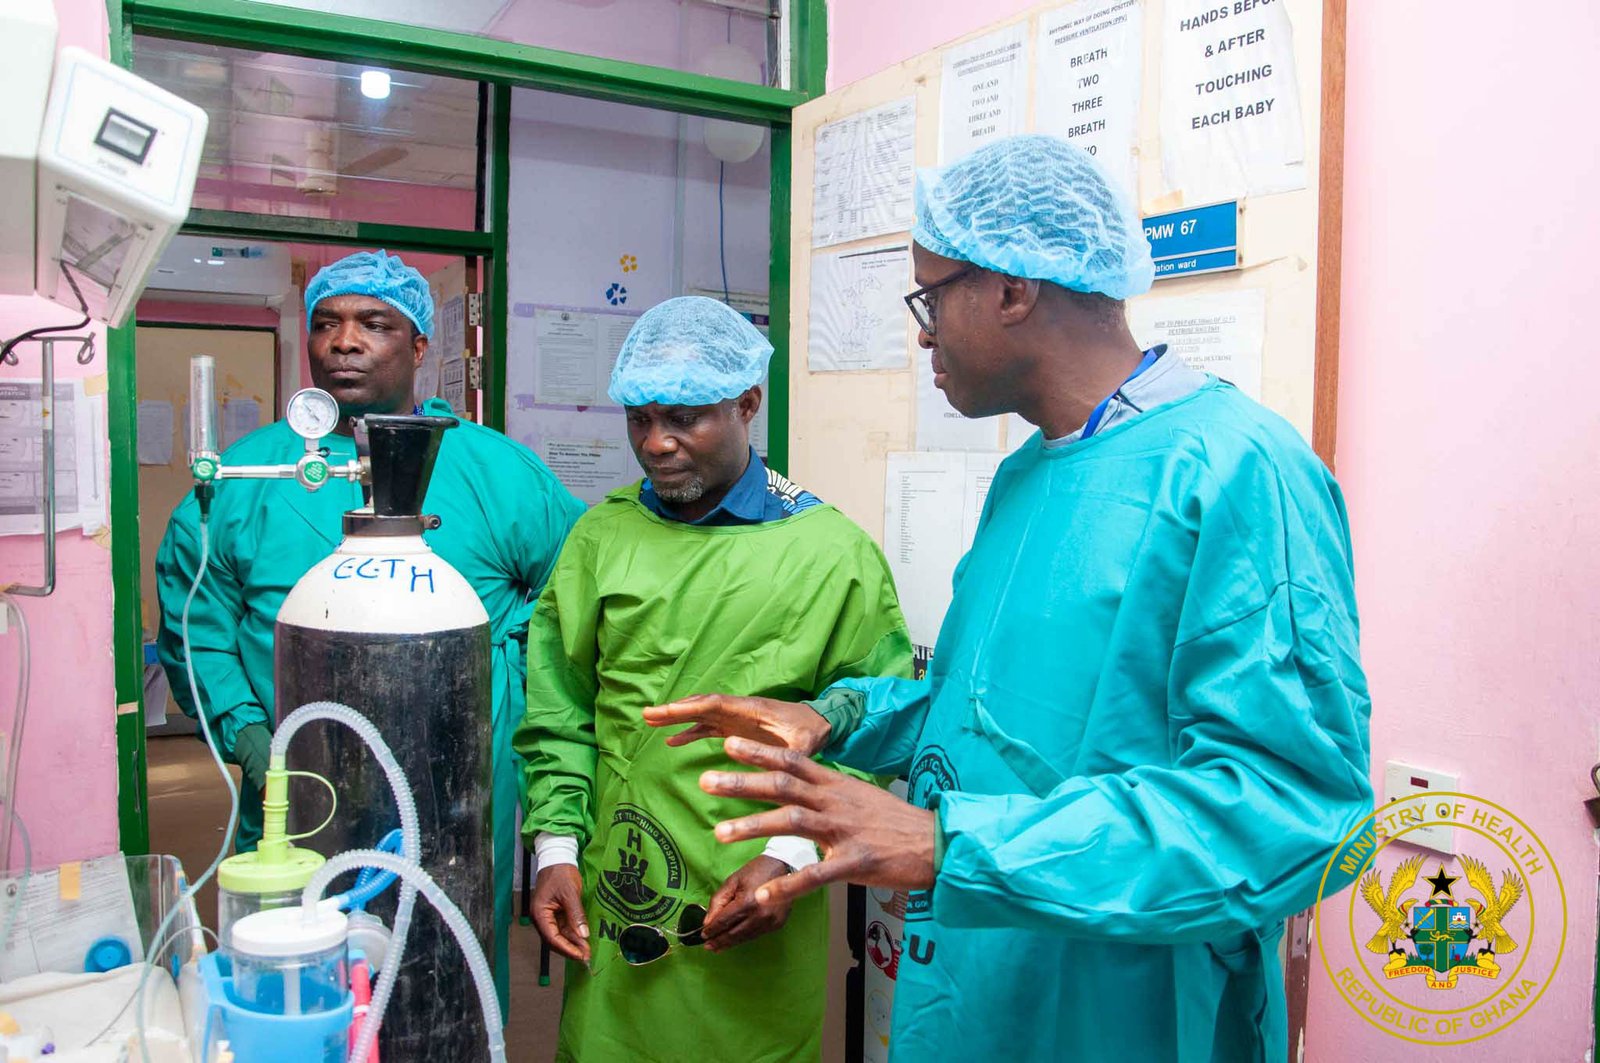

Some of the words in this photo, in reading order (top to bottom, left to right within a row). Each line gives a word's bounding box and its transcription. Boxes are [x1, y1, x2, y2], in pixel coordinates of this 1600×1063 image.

[1073, 18, 1084, 27] WAY
[1093, 8, 1110, 19] DOING
[1180, 6, 1228, 32] HANDS
[1079, 21, 1112, 37] VENTILATION
[1204, 45, 1214, 58] &
[1218, 28, 1265, 53] AFTER
[1070, 48, 1108, 68] BREATH
[1077, 74, 1099, 89] TWO
[1195, 64, 1272, 95] TOUCHING
[986, 94, 999, 103] AND
[1072, 96, 1103, 113] THREE
[1191, 110, 1230, 130] EACH
[1235, 98, 1275, 120] BABY
[1068, 119, 1106, 138] BREATH
[1144, 223, 1175, 240] PMW
[1180, 219, 1197, 235] 67
[1155, 263, 1174, 272] ation
[1177, 259, 1197, 269] ward
[659, 837, 678, 882] HOSPITAL
